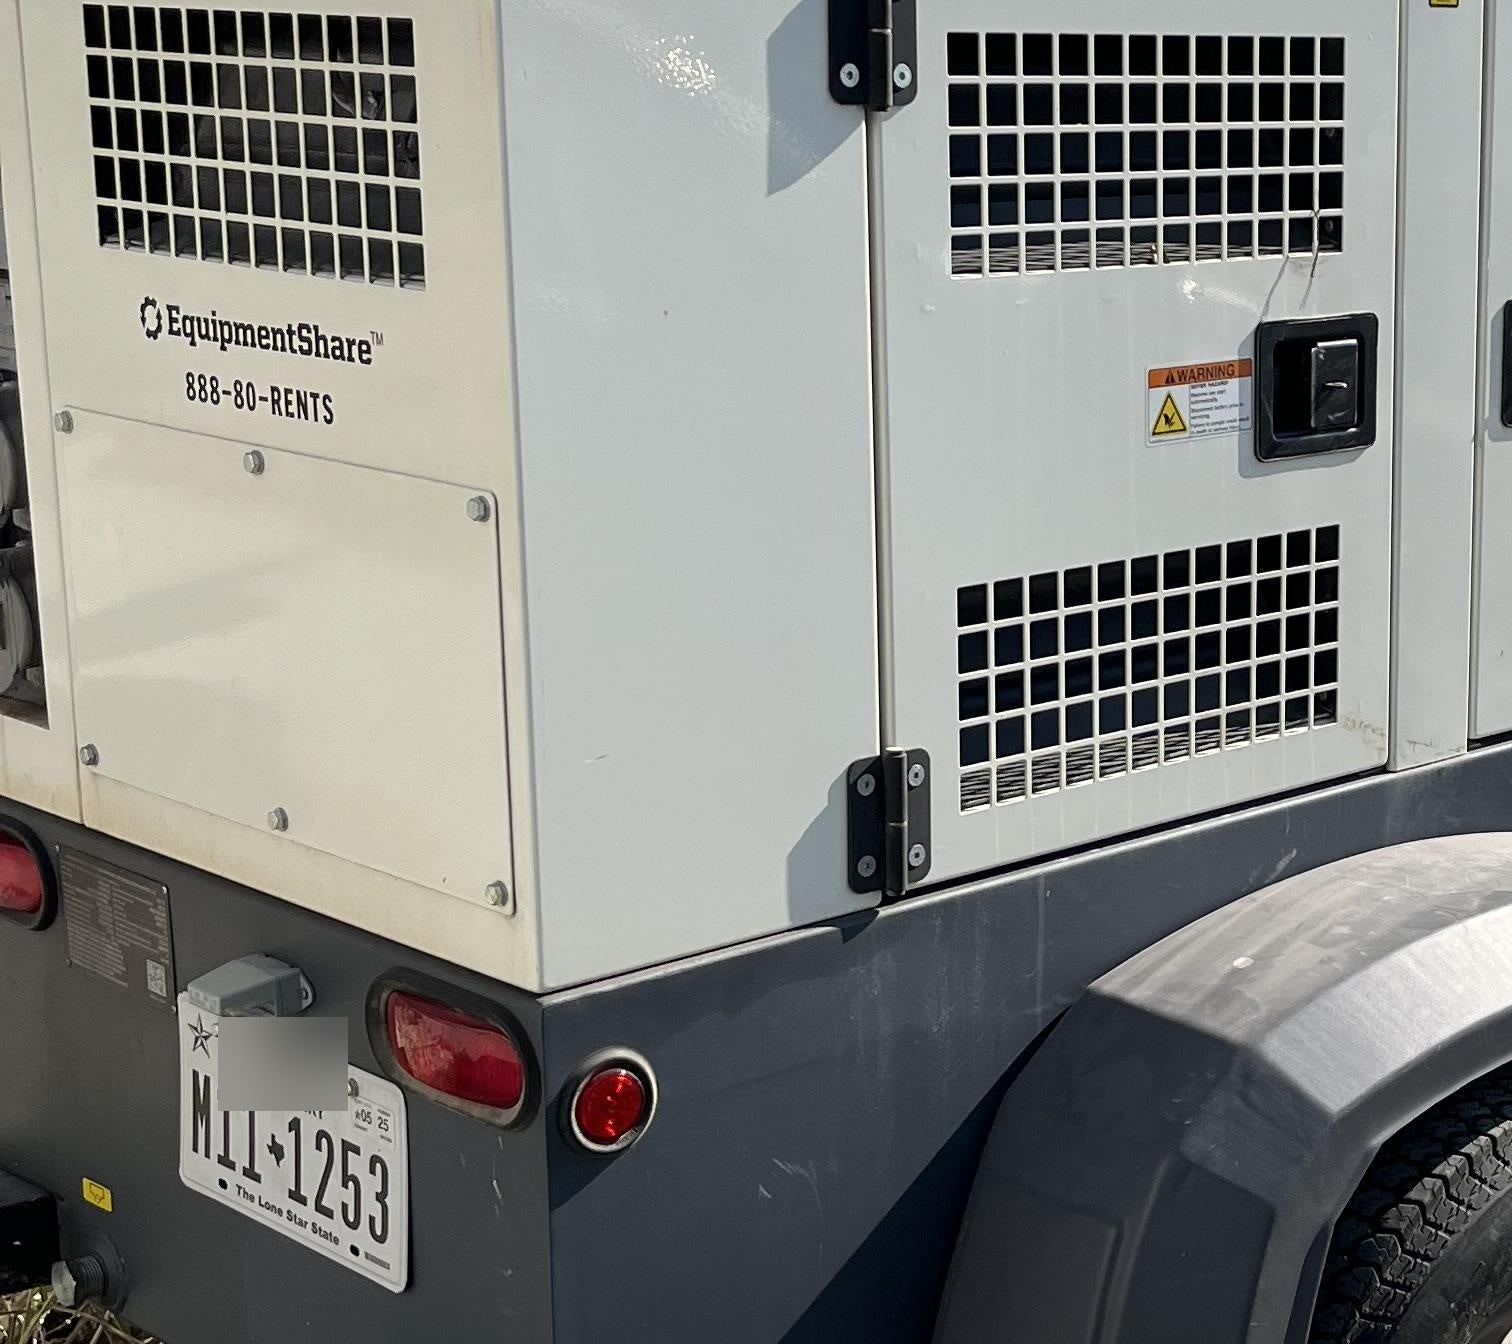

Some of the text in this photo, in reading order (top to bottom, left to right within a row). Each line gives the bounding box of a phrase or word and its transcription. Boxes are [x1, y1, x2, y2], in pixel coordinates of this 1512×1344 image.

[185, 370, 335, 425] 888-80-RENTS
[1176, 363, 1236, 383] WARNING
[377, 1115, 390, 1132] 25
[287, 1115, 390, 1245] 1253
[235, 1183, 341, 1246] The Lone Star State
